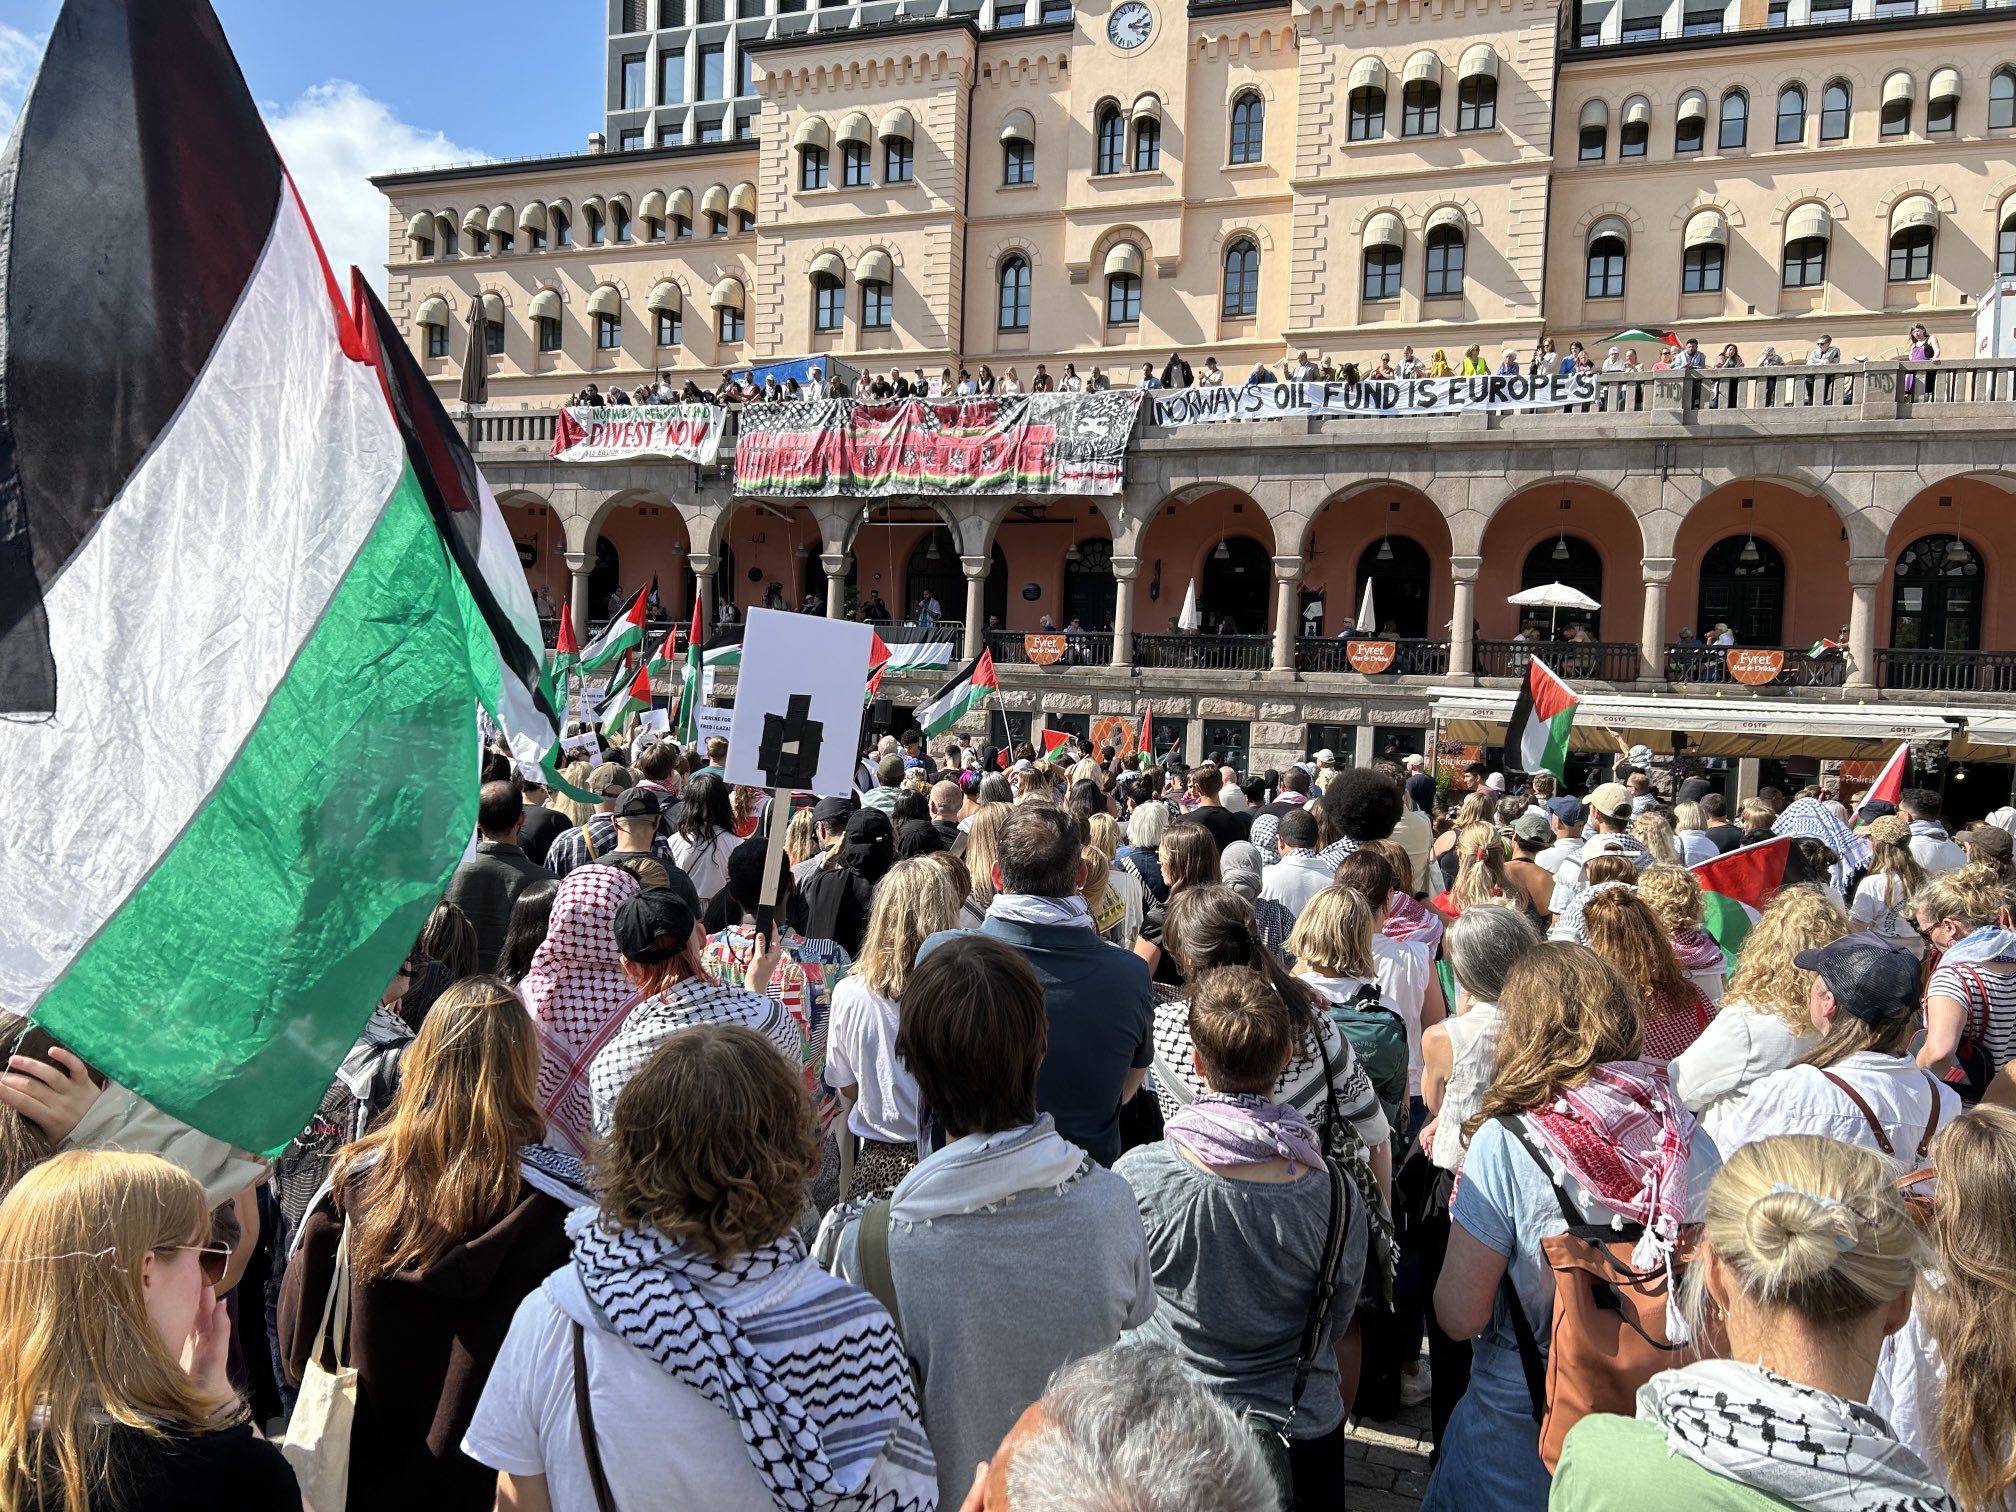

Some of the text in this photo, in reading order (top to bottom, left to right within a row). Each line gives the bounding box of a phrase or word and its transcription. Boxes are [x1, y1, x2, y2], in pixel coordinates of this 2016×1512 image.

[1155, 384, 1264, 426] NORWAY'S
[1273, 383, 1312, 410] OIL
[1322, 381, 1400, 410] FUND
[1407, 379, 1438, 408] IS
[644, 404, 683, 420] PENSION
[589, 419, 710, 447] DIVEST NOW
[1034, 637, 1057, 649] Fyret
[1357, 644, 1385, 657] Fyret
[1739, 652, 1772, 666] Fyret
[1352, 1040, 1377, 1049] OSPREY
